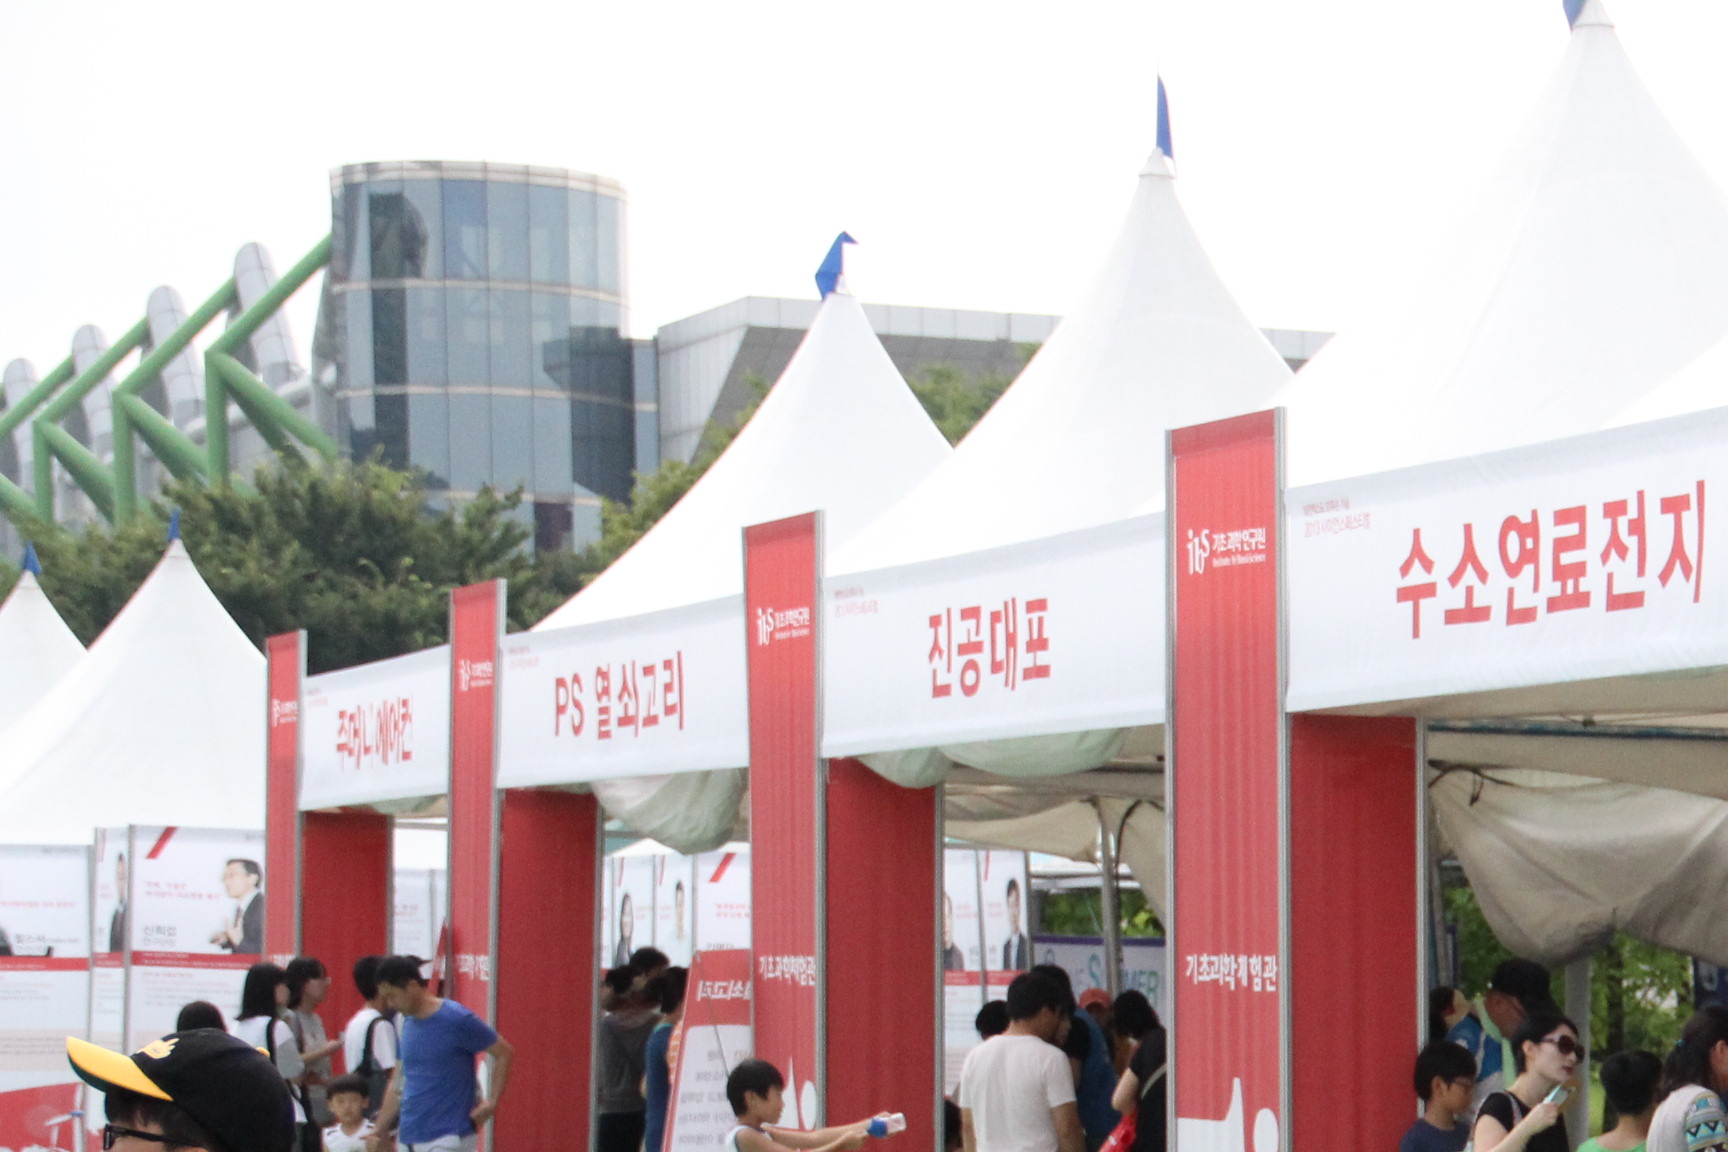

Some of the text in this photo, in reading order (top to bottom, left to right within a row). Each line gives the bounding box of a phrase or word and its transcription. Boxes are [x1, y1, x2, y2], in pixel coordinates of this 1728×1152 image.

[1212, 527, 1266, 554] 기초과학연구원
[1395, 480, 1707, 640] 수소연료전지
[928, 597, 1050, 698] 진공대포
[336, 694, 413, 772] 주머니에어컨
[555, 650, 685, 741] PS 열쇠고리
[1185, 952, 1278, 993] 기초과학체험관
